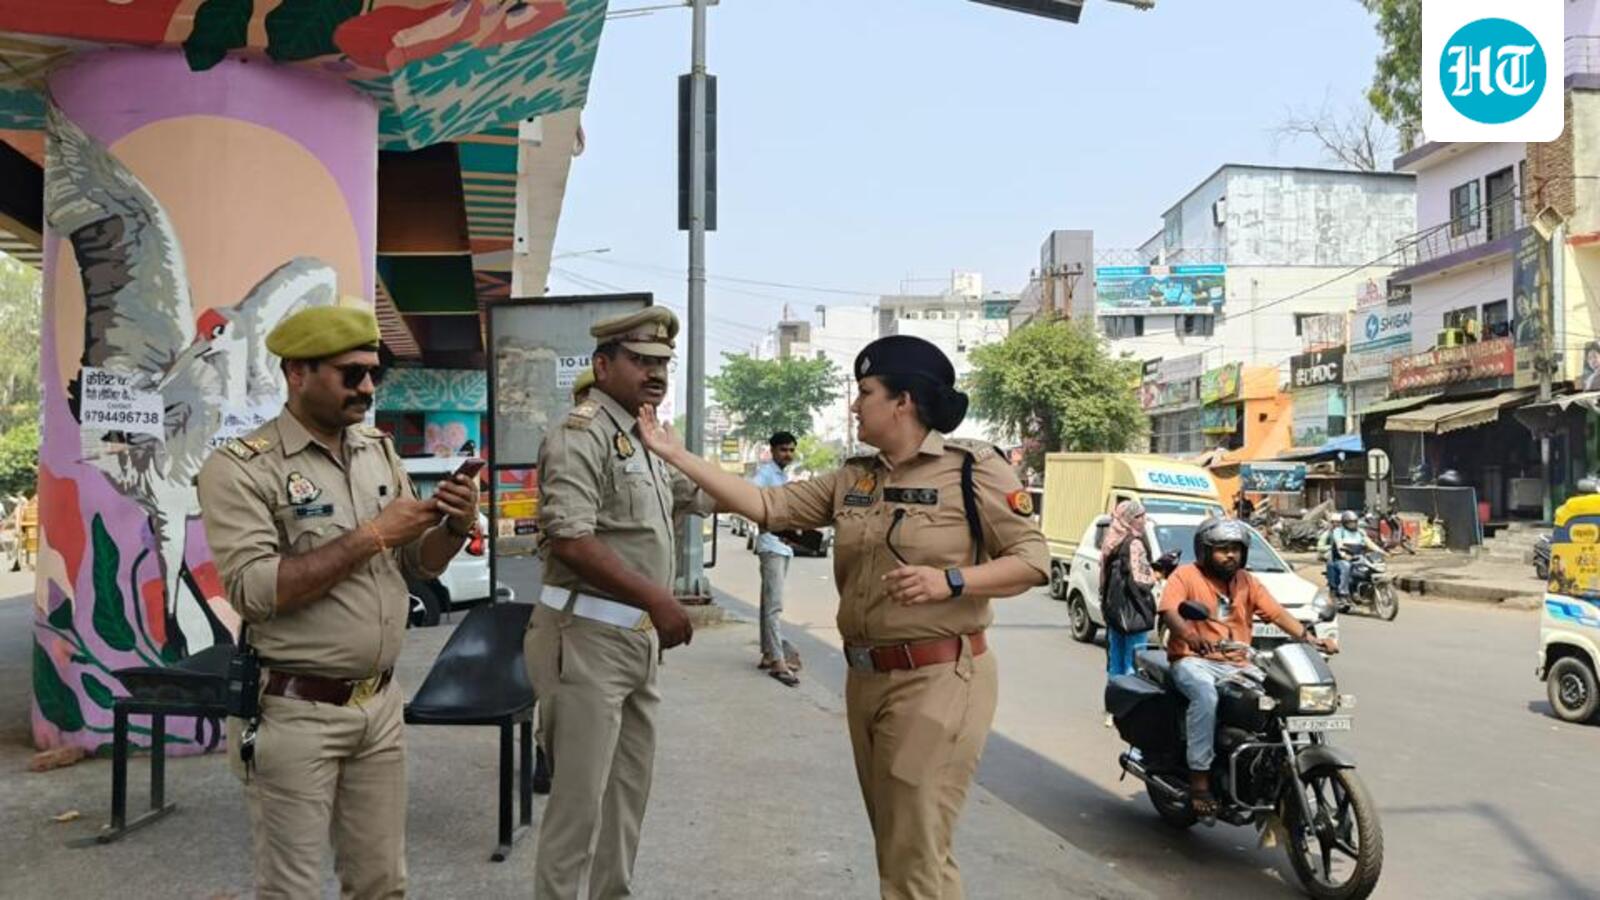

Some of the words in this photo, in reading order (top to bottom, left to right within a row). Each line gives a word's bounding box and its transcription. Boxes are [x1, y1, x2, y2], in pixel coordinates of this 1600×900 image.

[559, 357, 576, 367] TO
[84, 410, 159, 424] 9794496738
[1148, 472, 1209, 489] COLENIS
